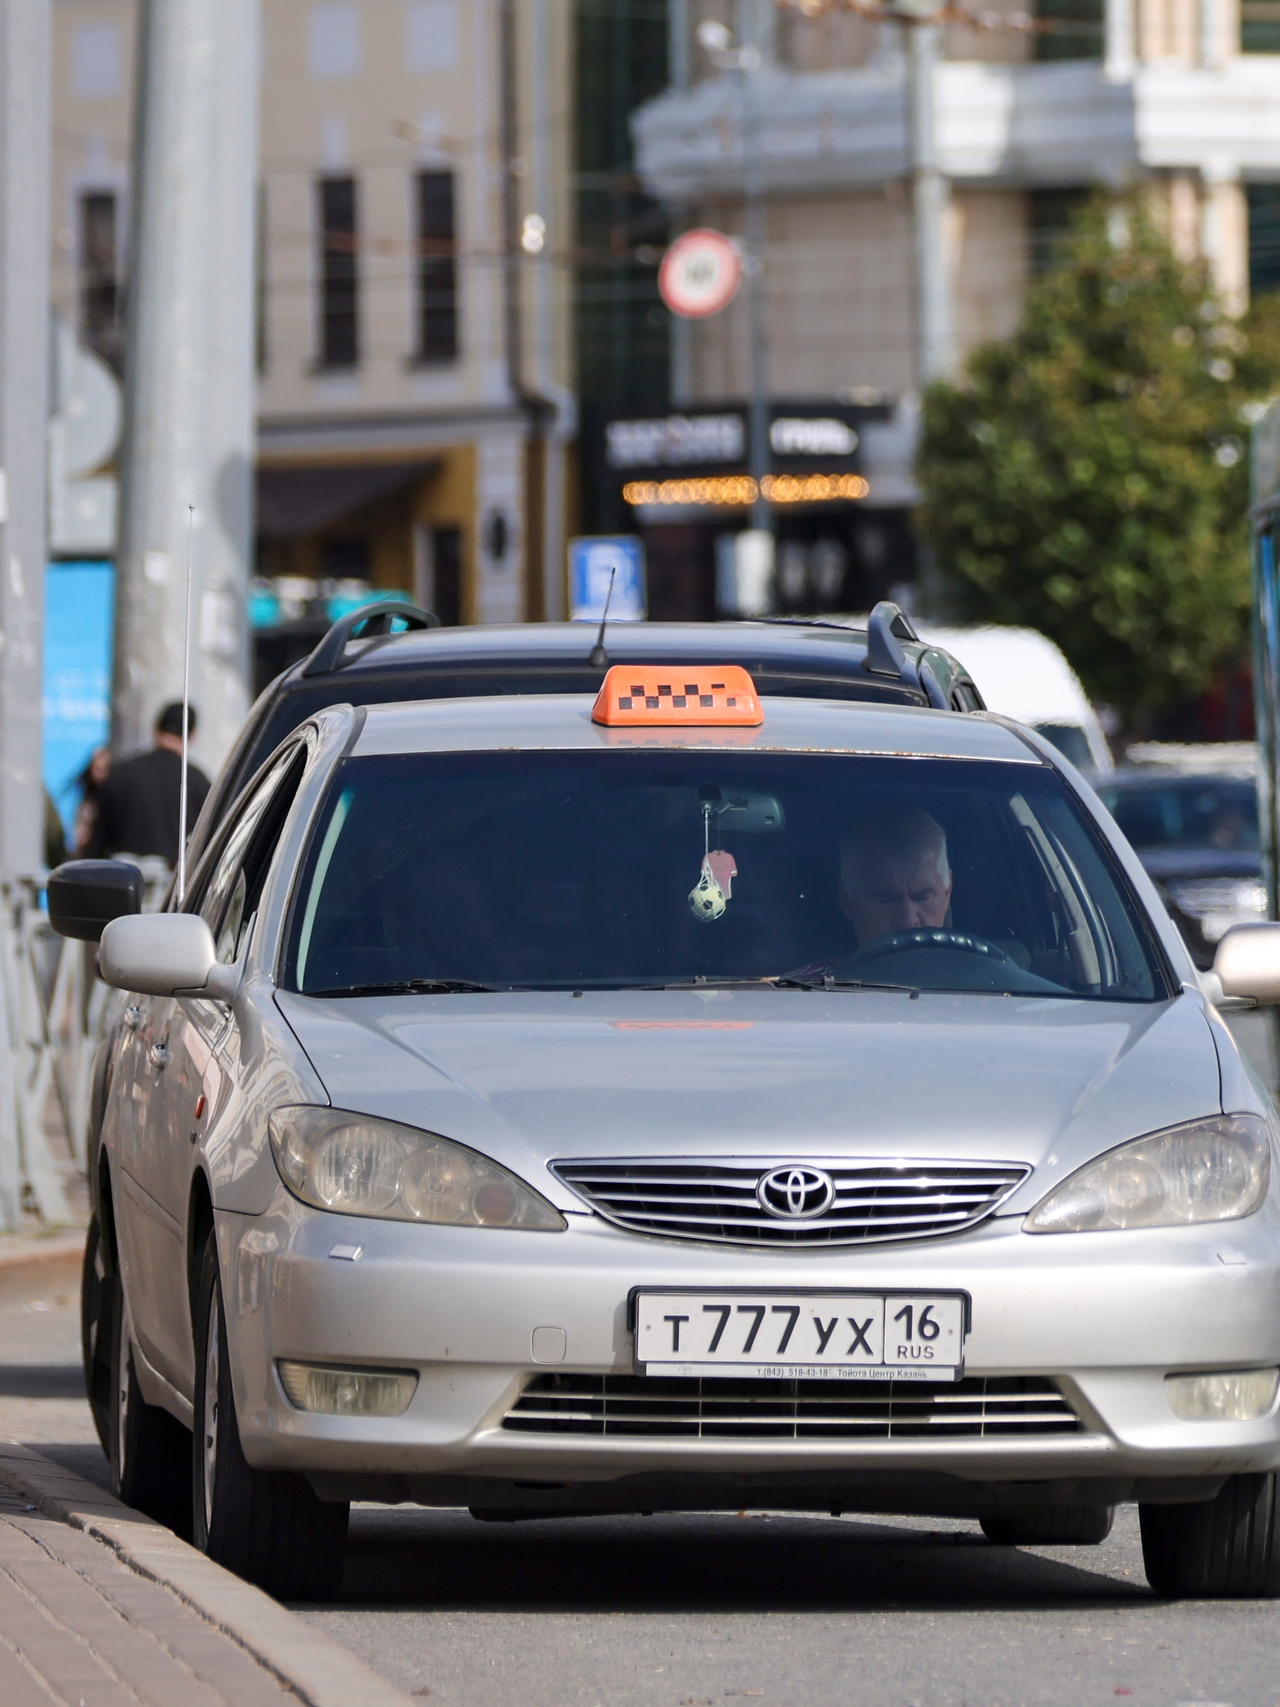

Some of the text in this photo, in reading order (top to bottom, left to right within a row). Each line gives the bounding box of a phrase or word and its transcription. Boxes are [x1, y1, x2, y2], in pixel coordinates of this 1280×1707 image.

[893, 1304, 941, 1341] 16
[897, 1345, 934, 1359] RUS
[788, 1368, 828, 1377] 518-43-18
[837, 1368, 865, 1377] Тойота
[869, 1369, 895, 1381] Центр
[897, 1370, 928, 1380] Казань
